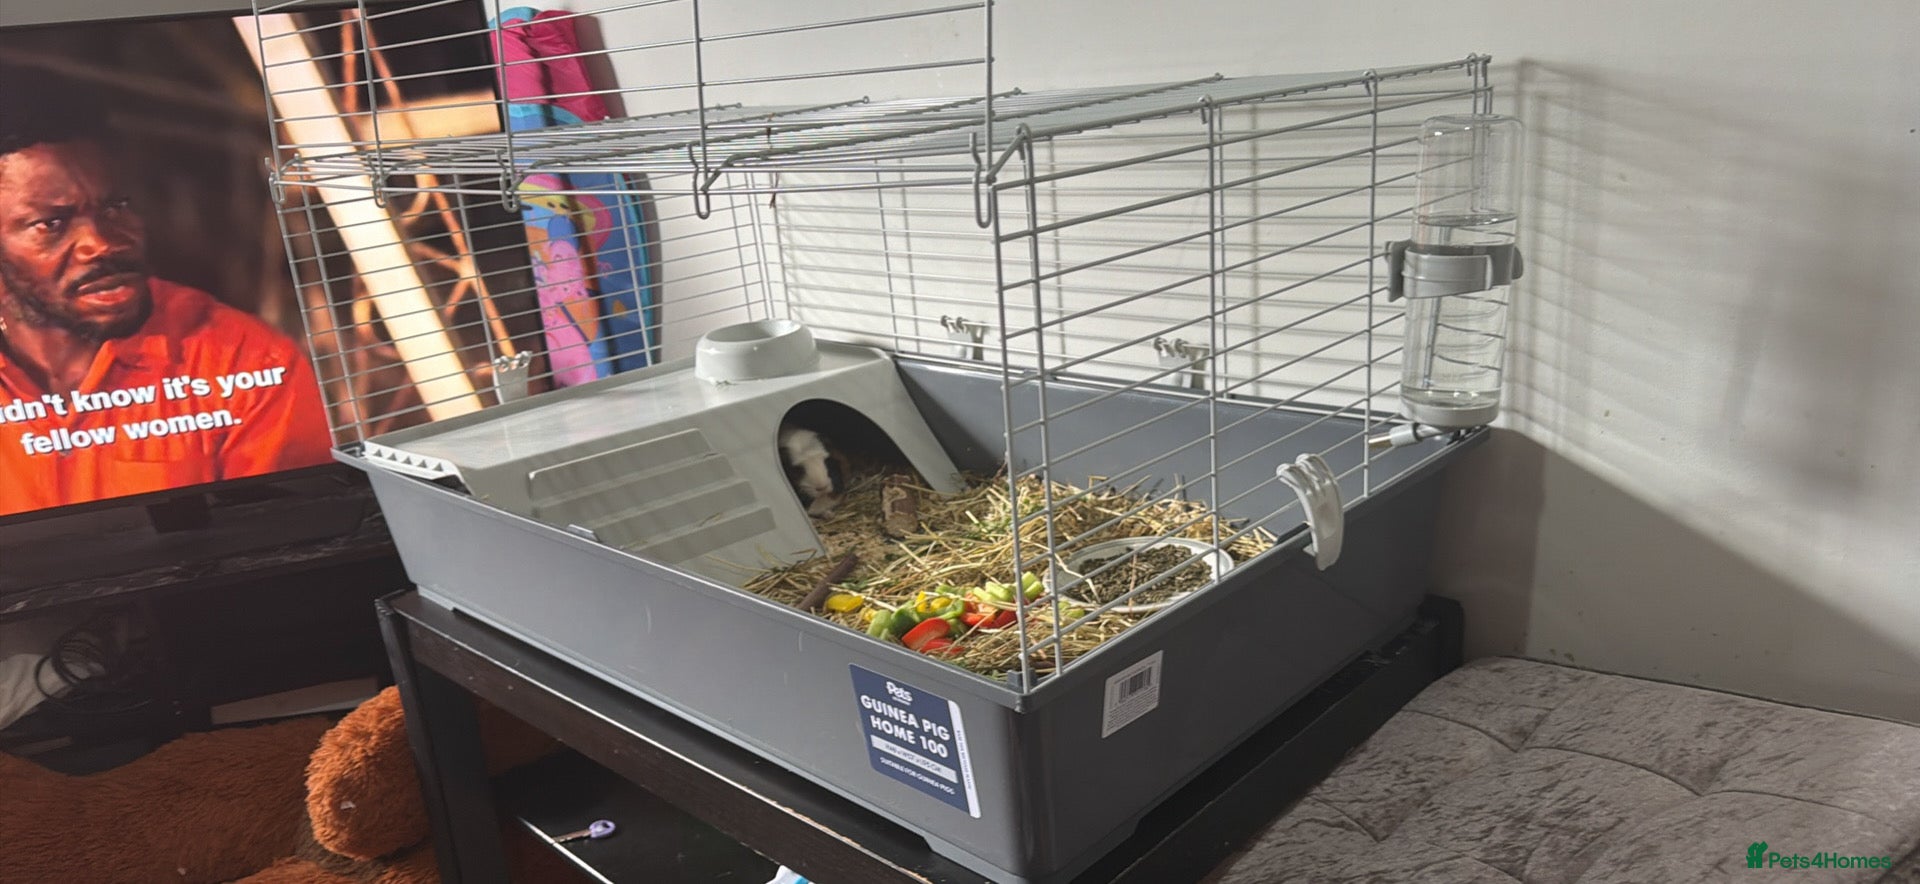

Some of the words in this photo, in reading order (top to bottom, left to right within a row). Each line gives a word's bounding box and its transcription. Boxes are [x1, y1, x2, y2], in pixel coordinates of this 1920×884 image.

[70, 385, 156, 412] know
[162, 375, 211, 400] it's
[216, 366, 286, 398] your
[20, 426, 116, 455] fellow
[122, 409, 242, 440] women.
[886, 681, 913, 702] Pets
[860, 695, 919, 729] GUINEA
[921, 718, 950, 741] PIG
[870, 715, 916, 744] HOME
[919, 735, 948, 758] 100
